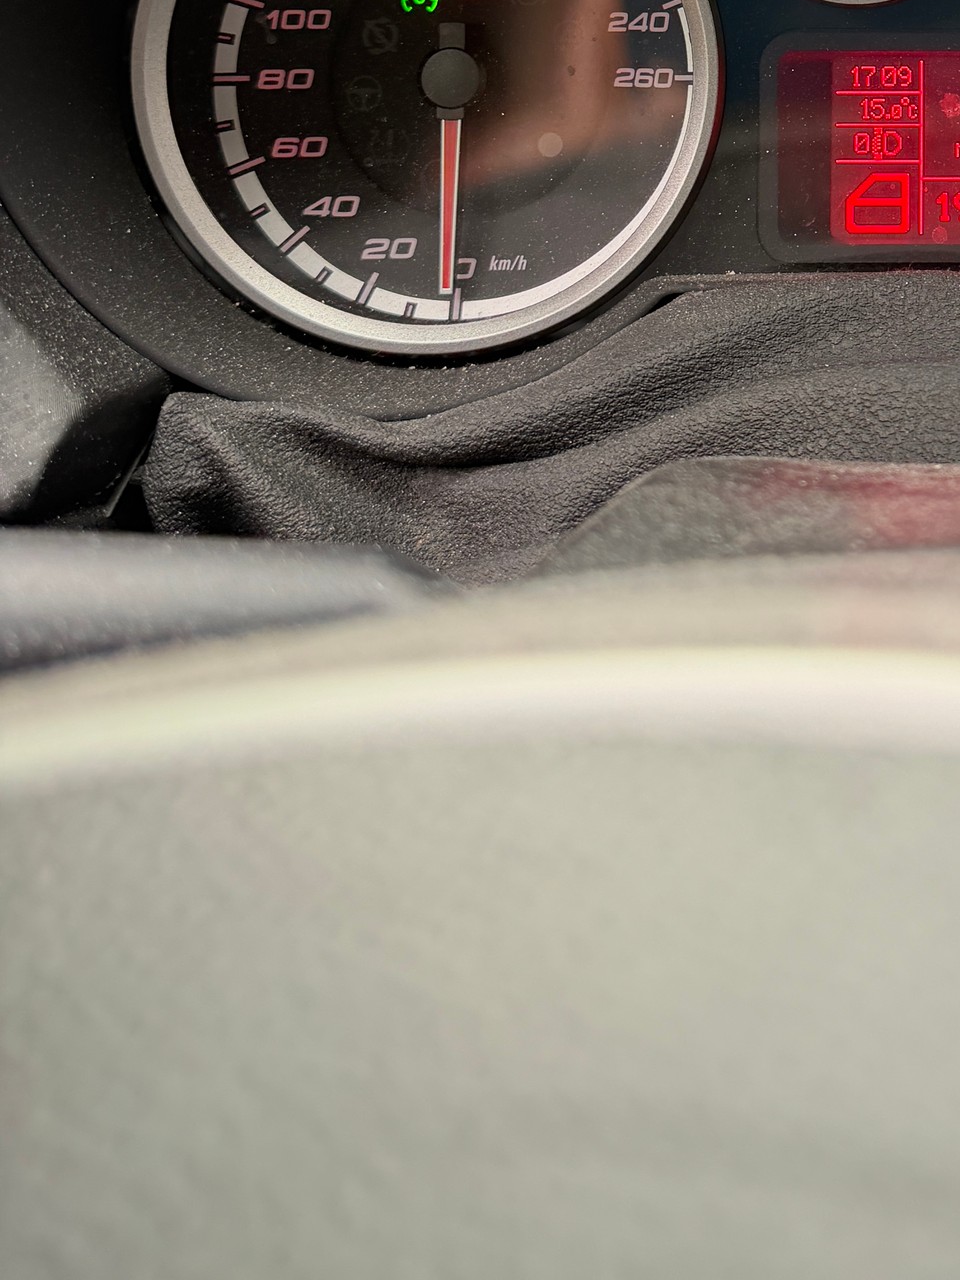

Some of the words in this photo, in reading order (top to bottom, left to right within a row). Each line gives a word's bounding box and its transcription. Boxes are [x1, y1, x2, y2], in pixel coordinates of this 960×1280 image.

[266, 10, 332, 30] 100
[608, 12, 670, 33] 240
[257, 69, 315, 90] 80
[614, 68, 673, 88] 260
[272, 136, 329, 157] 60
[303, 196, 361, 217] 40
[361, 238, 417, 259] 20
[488, 255, 528, 271] km/h
